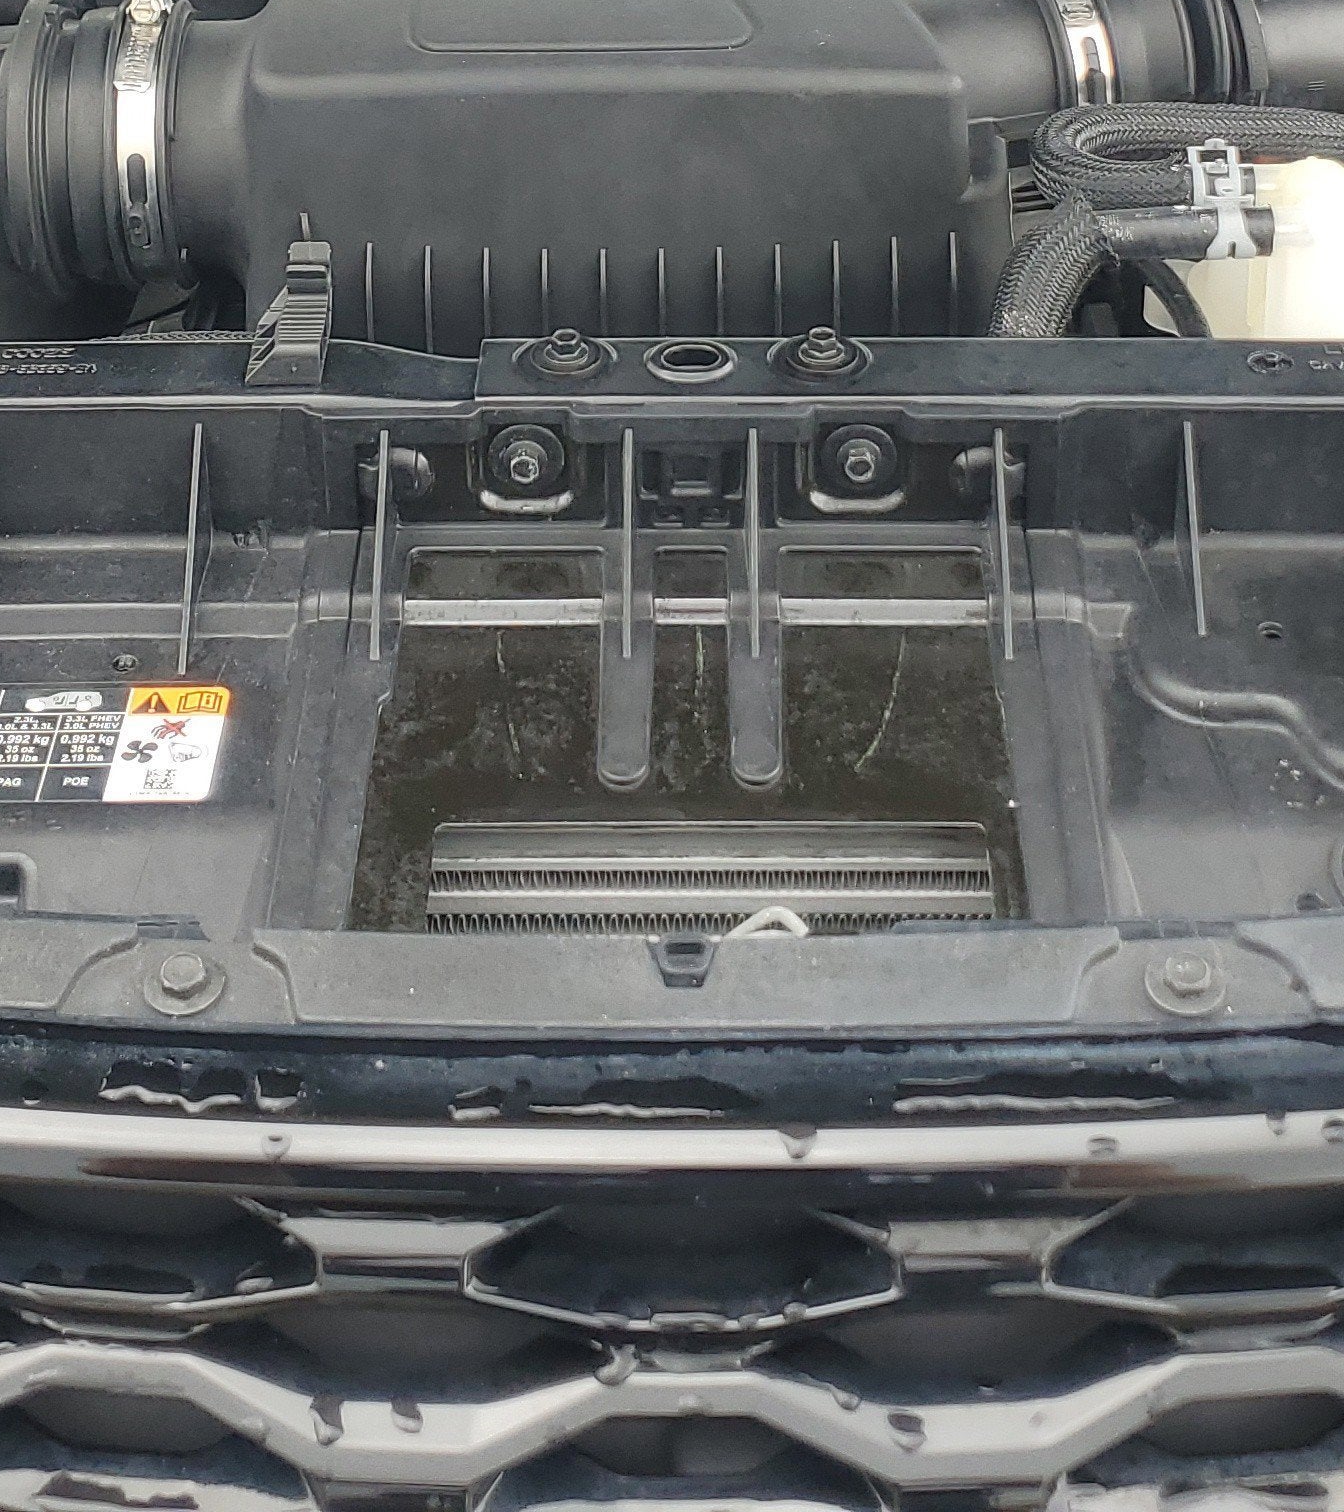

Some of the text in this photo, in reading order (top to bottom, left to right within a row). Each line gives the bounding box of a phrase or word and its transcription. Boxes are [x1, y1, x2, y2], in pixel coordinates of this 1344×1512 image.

[32, 734, 50, 746] kg
[60, 734, 115, 746] 0.992 kg
[85, 745, 101, 753] oz
[20, 754, 39, 762] lbs
[60, 753, 104, 763] 2.19 lbs
[62, 776, 90, 786] POE
